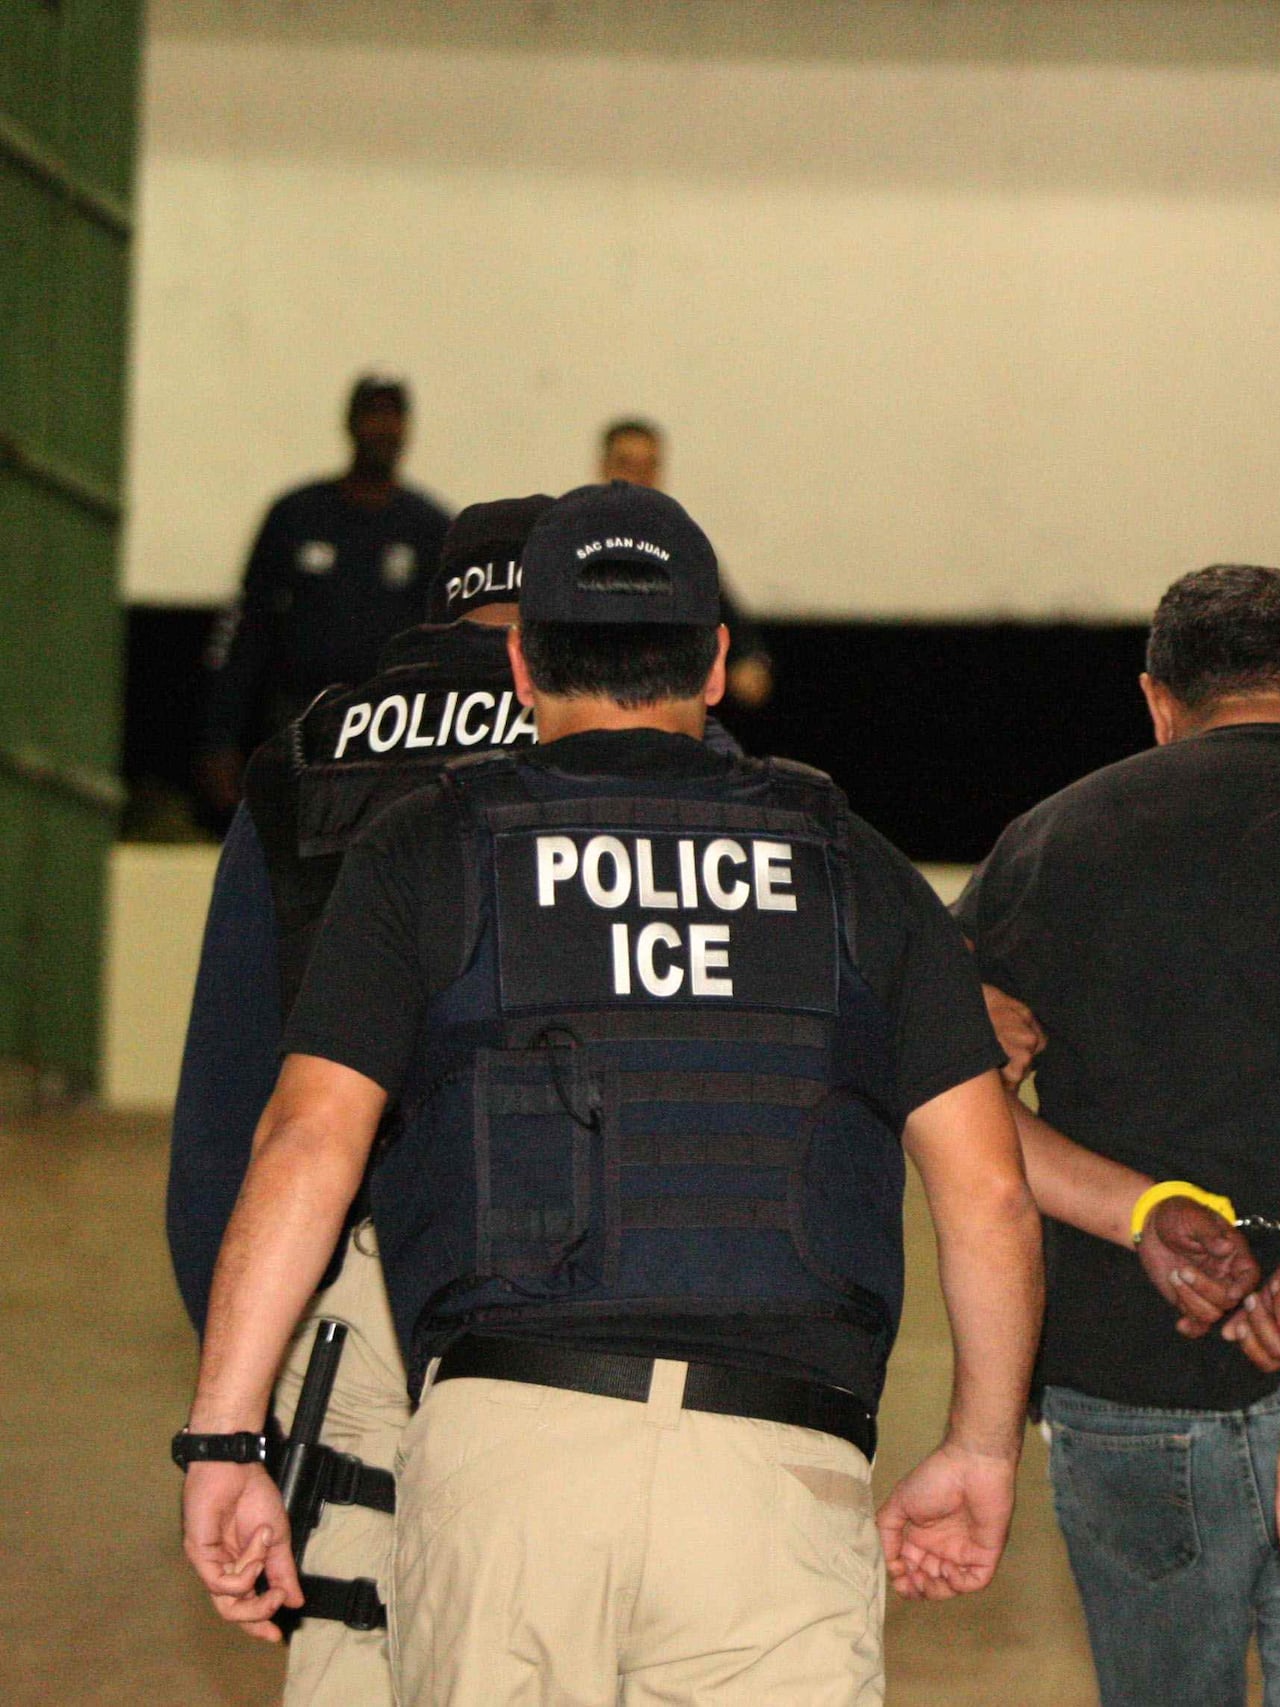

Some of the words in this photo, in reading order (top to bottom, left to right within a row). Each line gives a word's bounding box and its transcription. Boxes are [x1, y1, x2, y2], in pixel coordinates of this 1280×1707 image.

[576, 541, 602, 559] SAC
[605, 537, 633, 548] SAN
[636, 541, 670, 561] JUAN
[334, 691, 538, 759] POLICIA
[536, 835, 797, 911] POLICE
[612, 922, 733, 997] ICE
